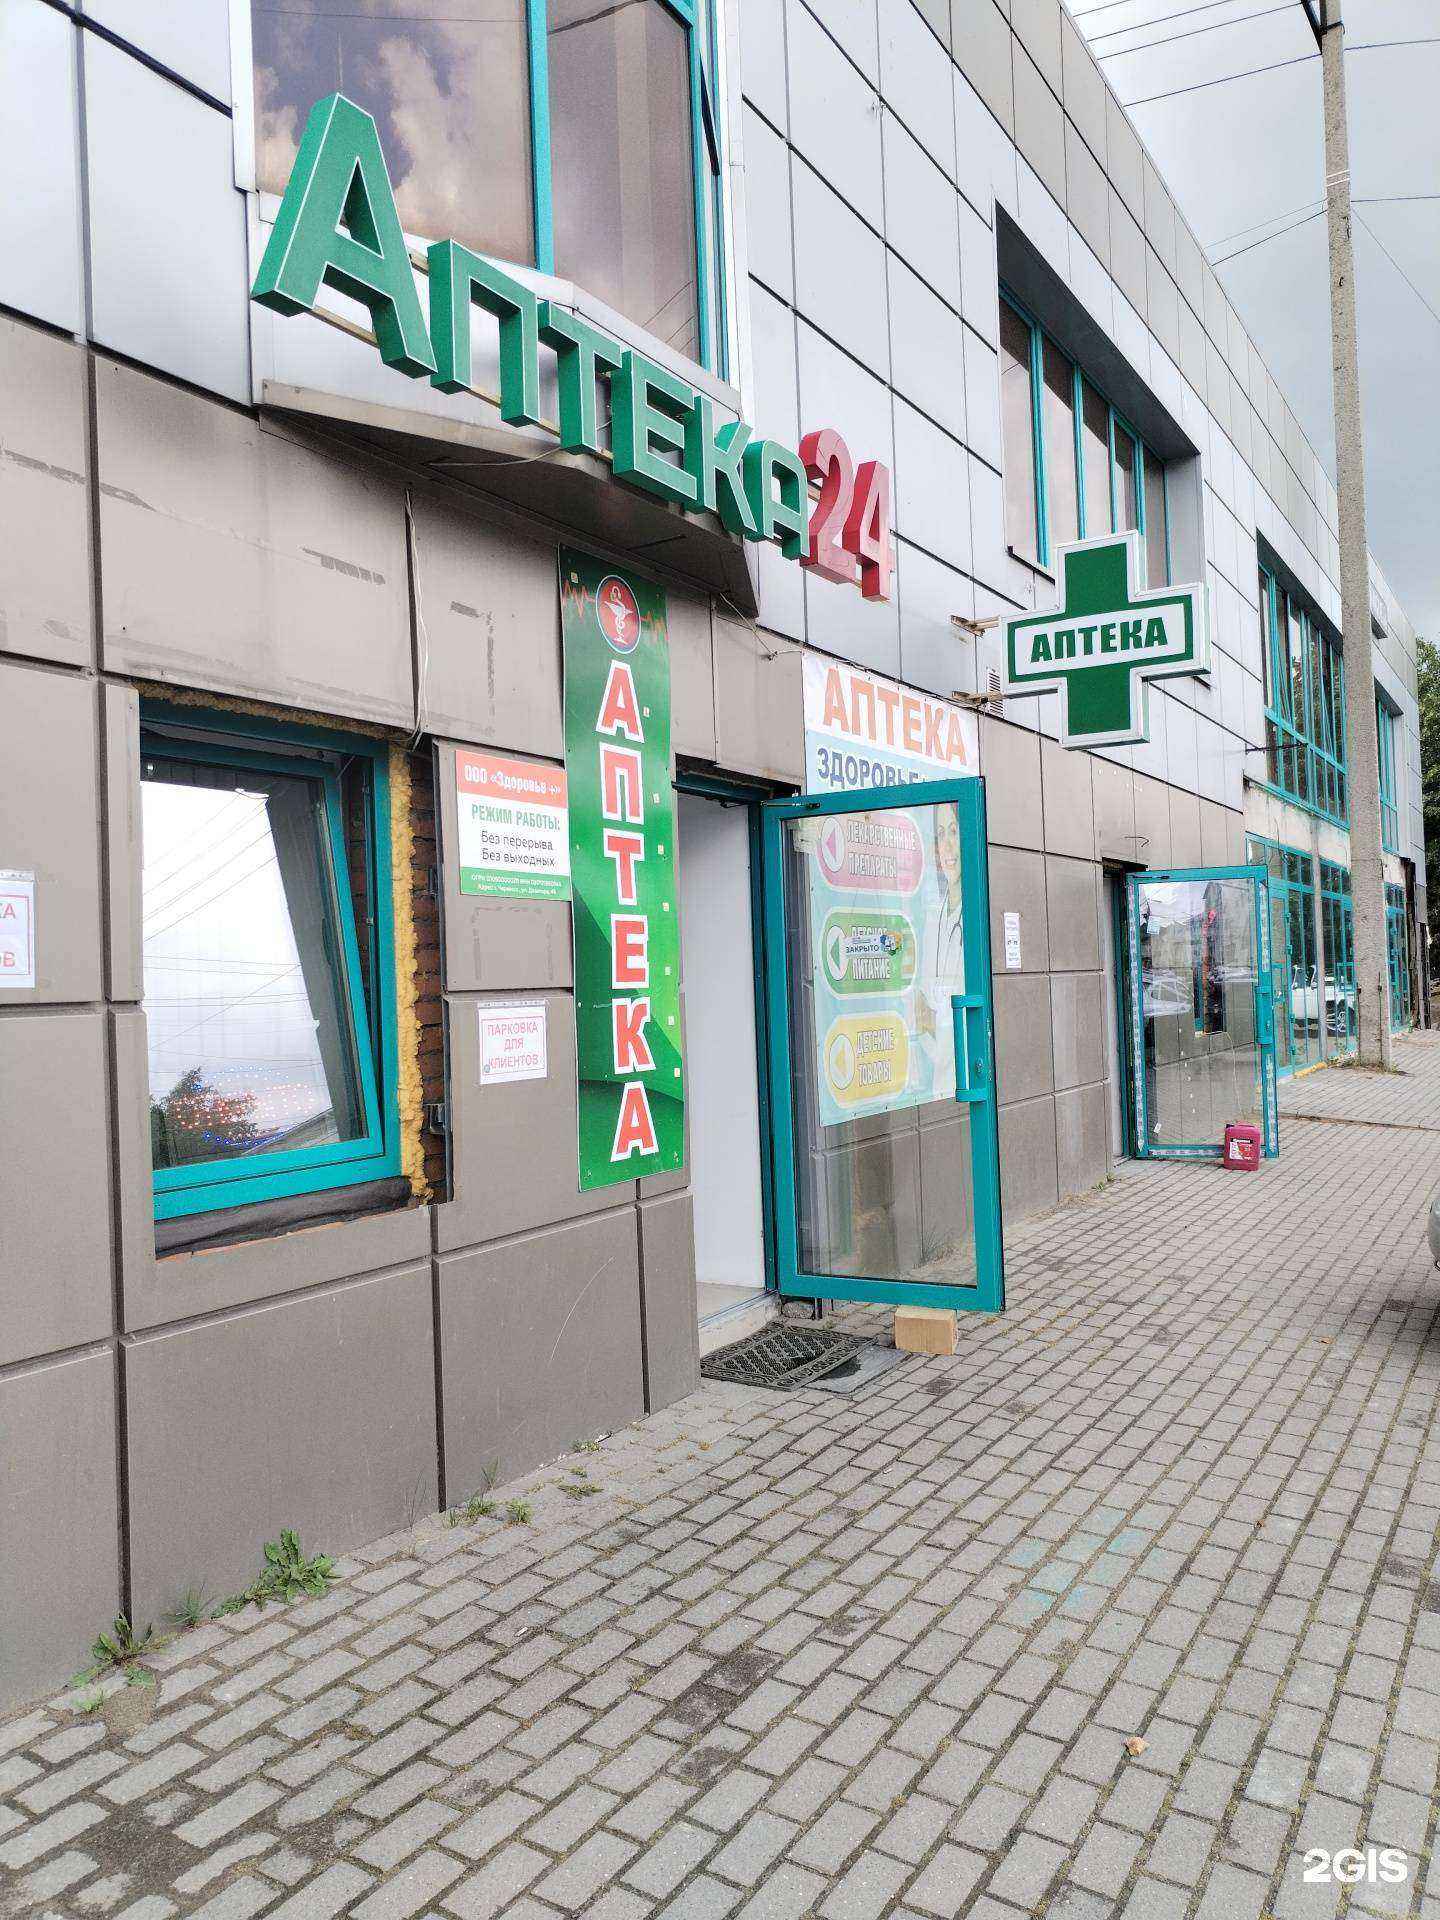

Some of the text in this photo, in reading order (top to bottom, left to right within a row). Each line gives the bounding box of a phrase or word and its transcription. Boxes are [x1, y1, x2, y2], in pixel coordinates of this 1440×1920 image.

[251, 92, 810, 560] АПТЕКА
[1030, 617, 1168, 664] АПТЕКА
[822, 666, 968, 766] АПТЕКА
[464, 765, 487, 784] ООО
[471, 804, 560, 831] РЕЖИМ РАБОТЫ:
[481, 830, 554, 851] Без перерыва
[482, 848, 556, 867] Без выходных
[595, 658, 659, 1163] АПТЕКА
[846, 944, 880, 954] ЗАКРЫТО
[852, 957, 891, 980] ПИТАНИЕ
[487, 1021, 539, 1036] ПАРКОВКА
[504, 1038, 524, 1052] ДЛЯ
[488, 1054, 539, 1069] КЛИЕНТОВ
